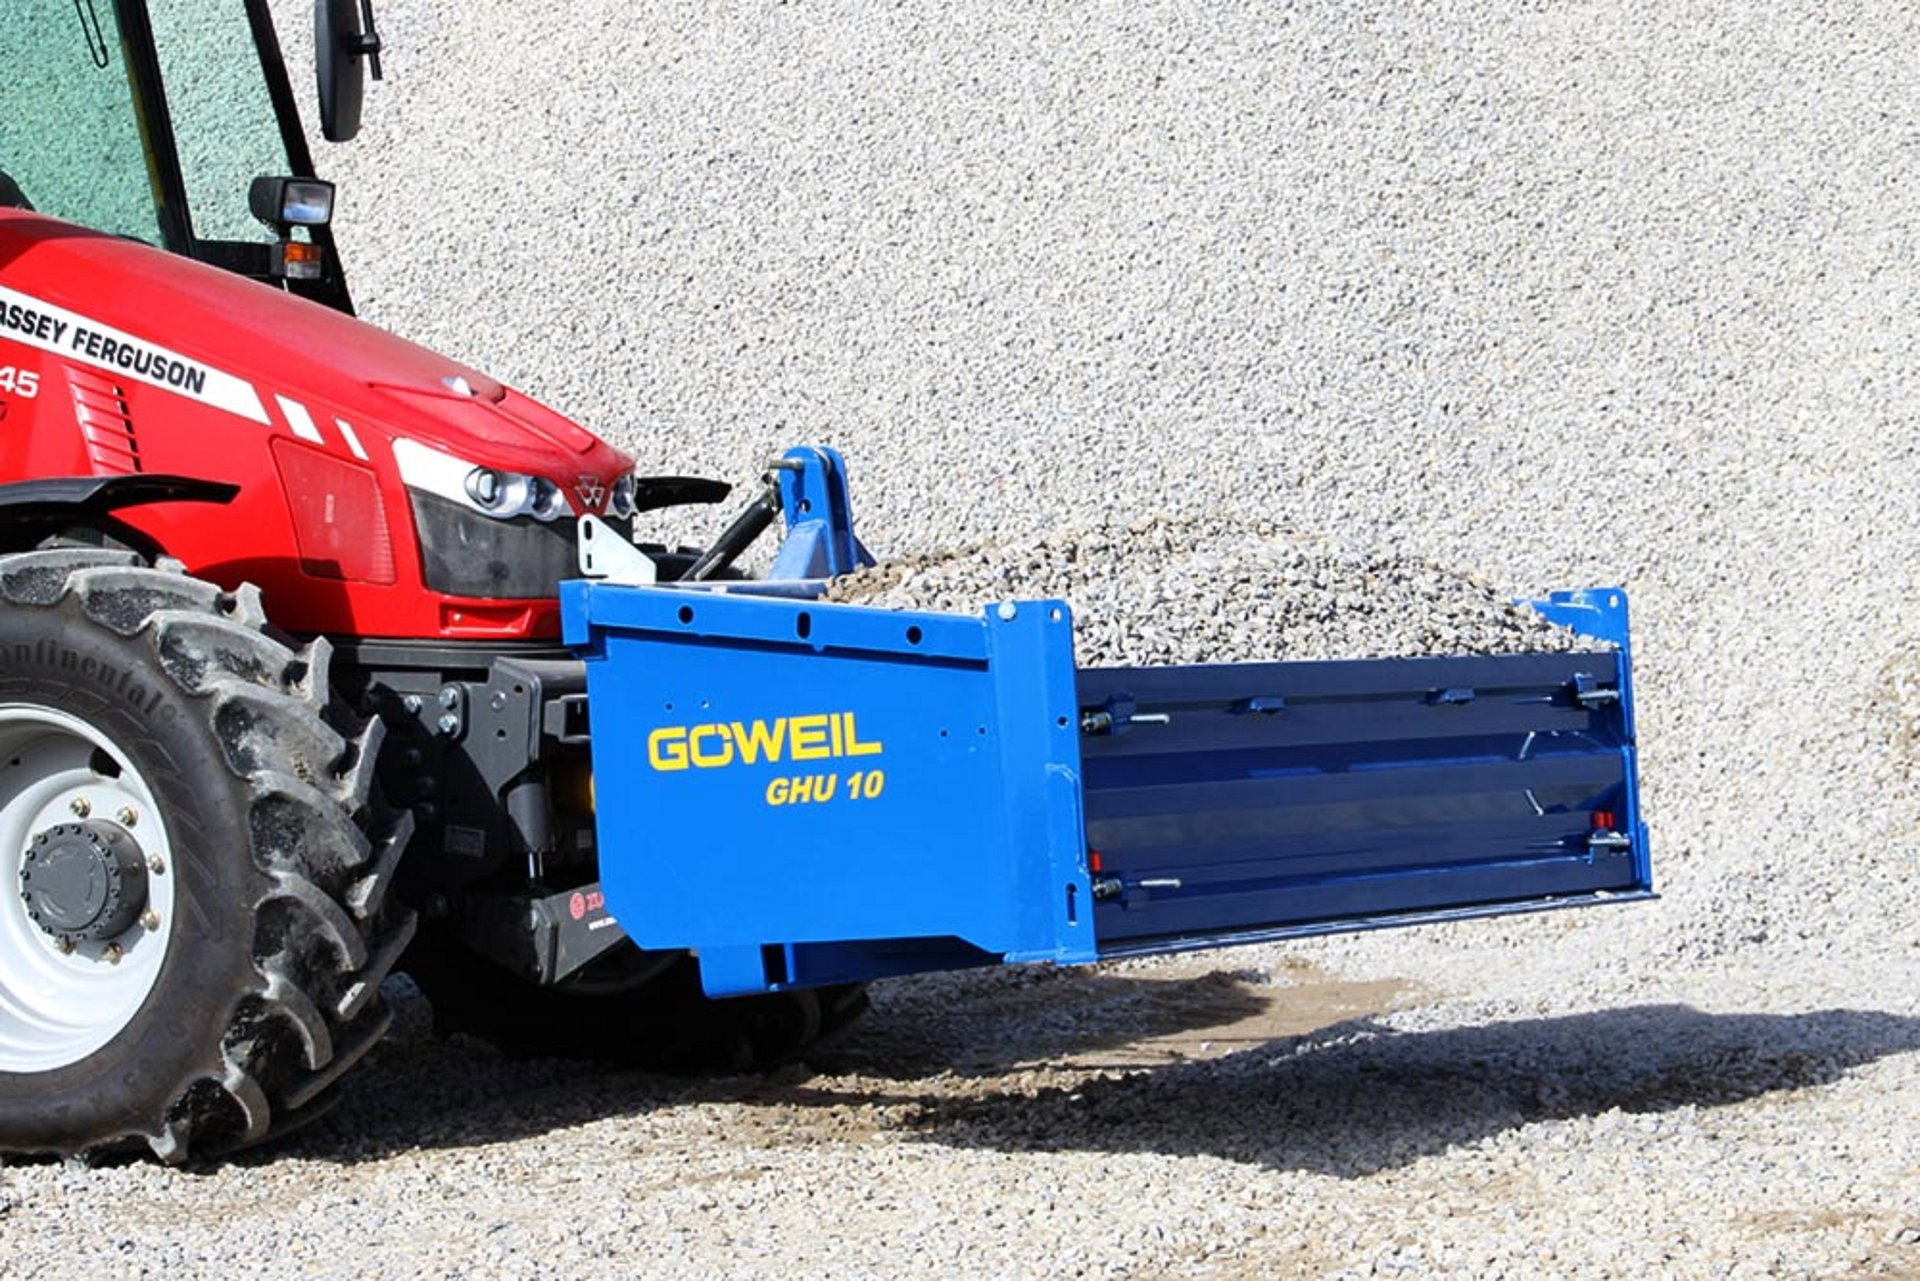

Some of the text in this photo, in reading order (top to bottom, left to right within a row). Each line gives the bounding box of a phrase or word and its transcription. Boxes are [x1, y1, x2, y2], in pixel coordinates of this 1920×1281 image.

[71, 328, 206, 394] FERGUSON
[0, 366, 40, 398] 45
[766, 770, 885, 806] GHU 10
